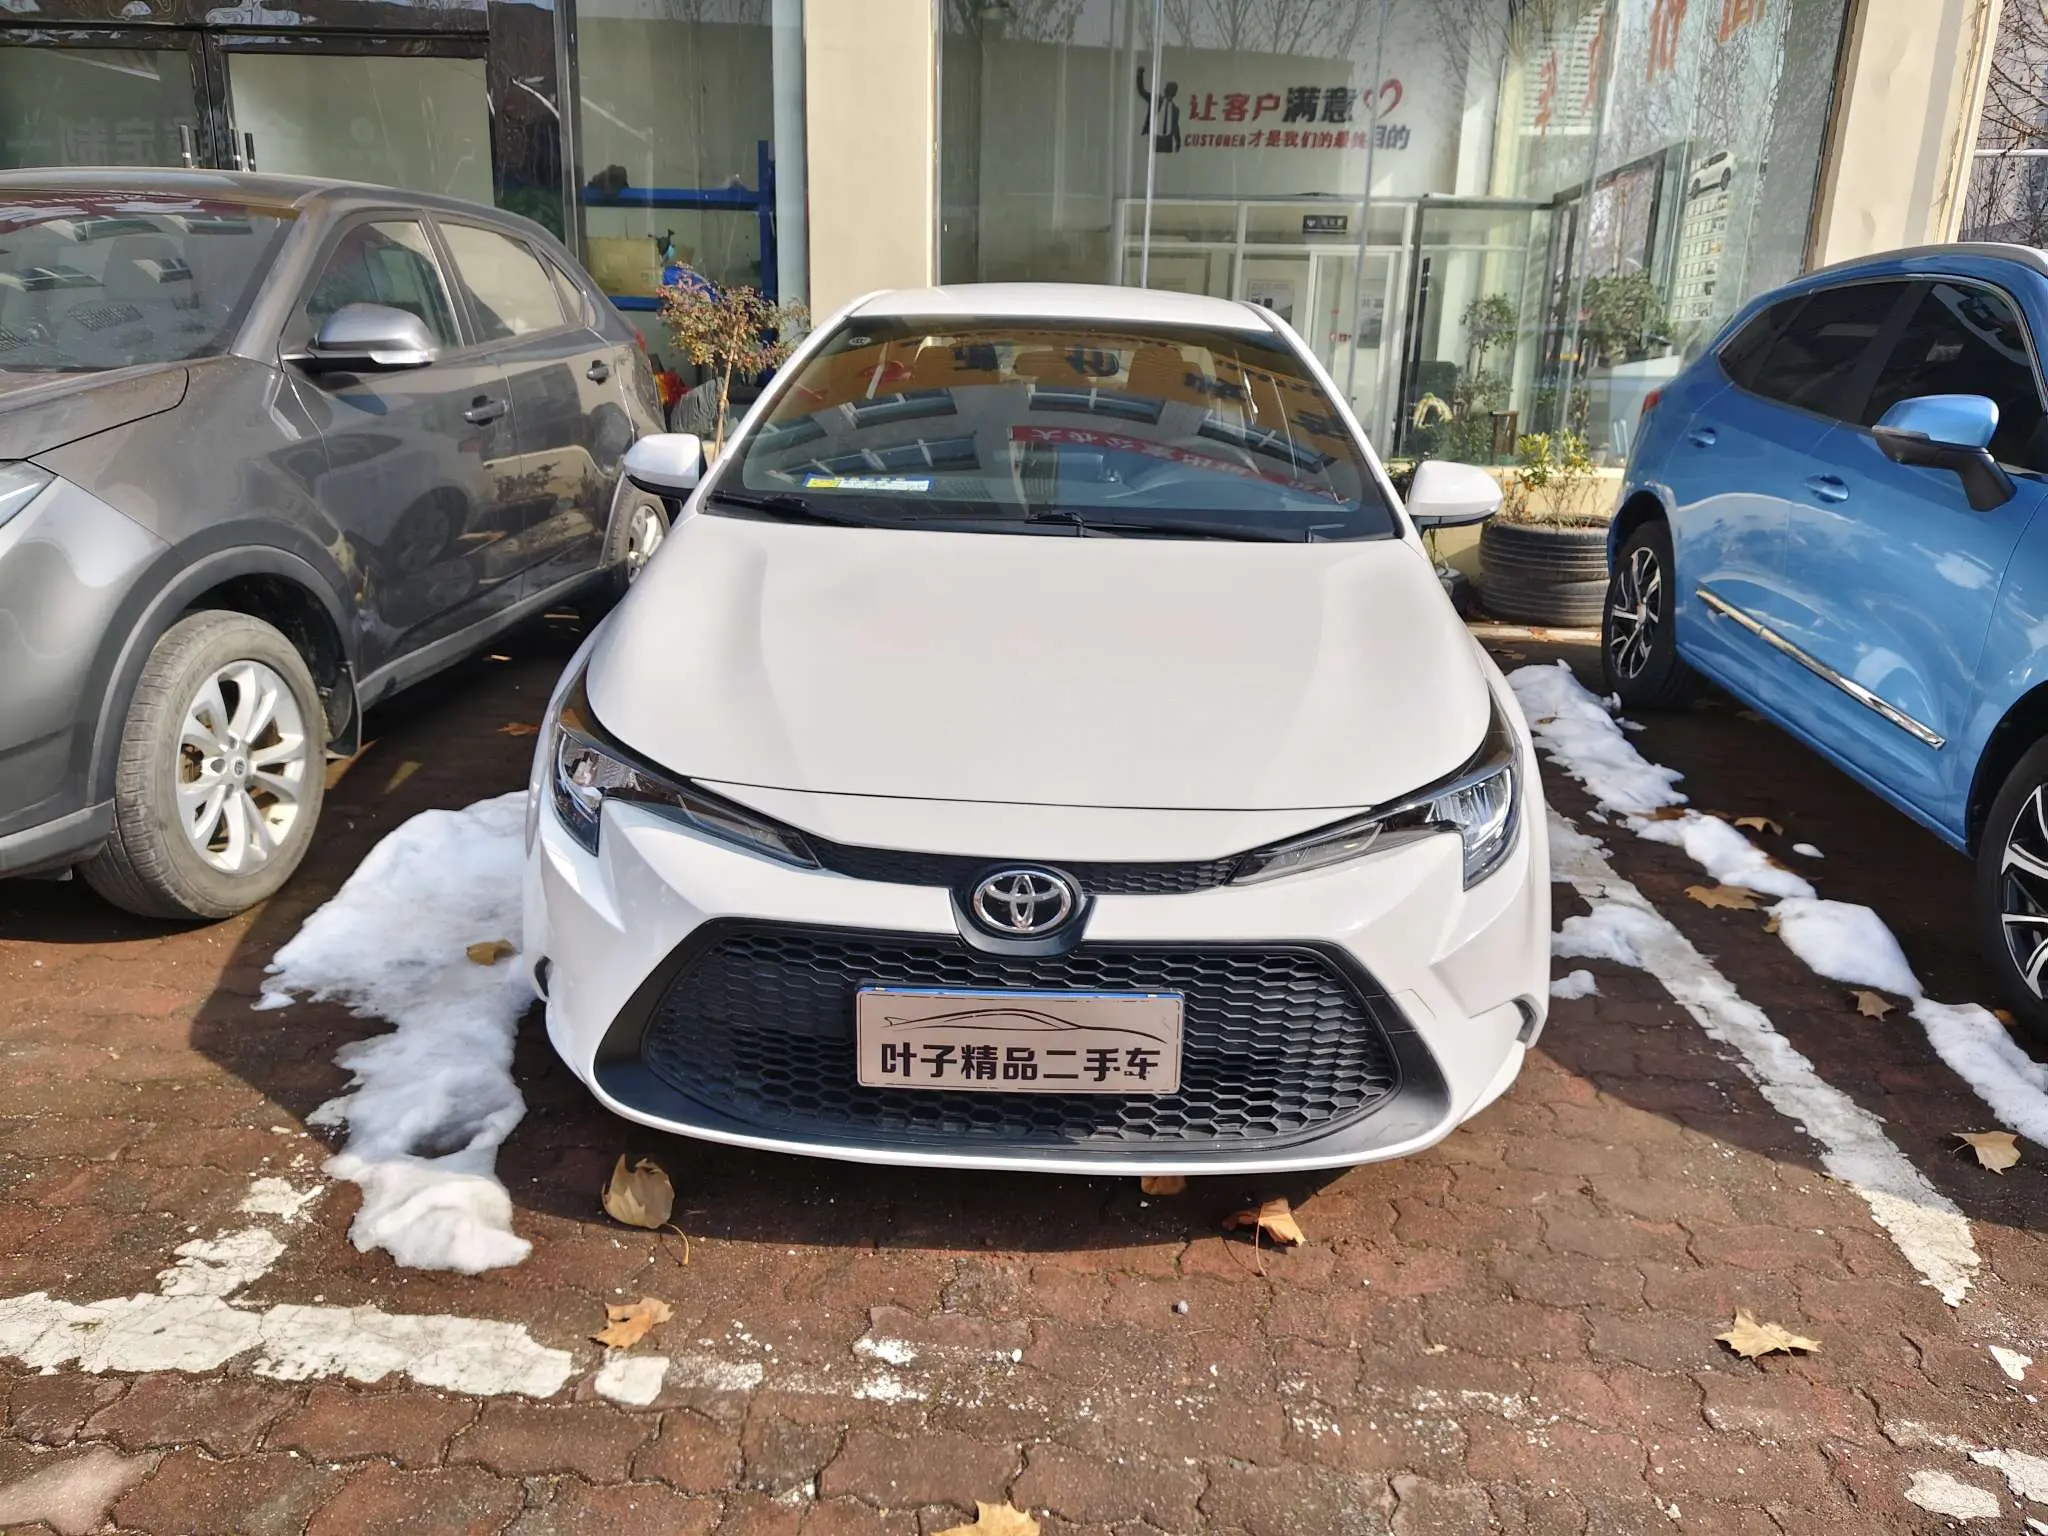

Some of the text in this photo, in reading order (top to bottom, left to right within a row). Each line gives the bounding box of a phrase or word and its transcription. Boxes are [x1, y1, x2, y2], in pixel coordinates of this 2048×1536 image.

[1189, 86, 1357, 123] 让客户满意
[881, 1042, 1161, 1082] 叶子精品二手车
